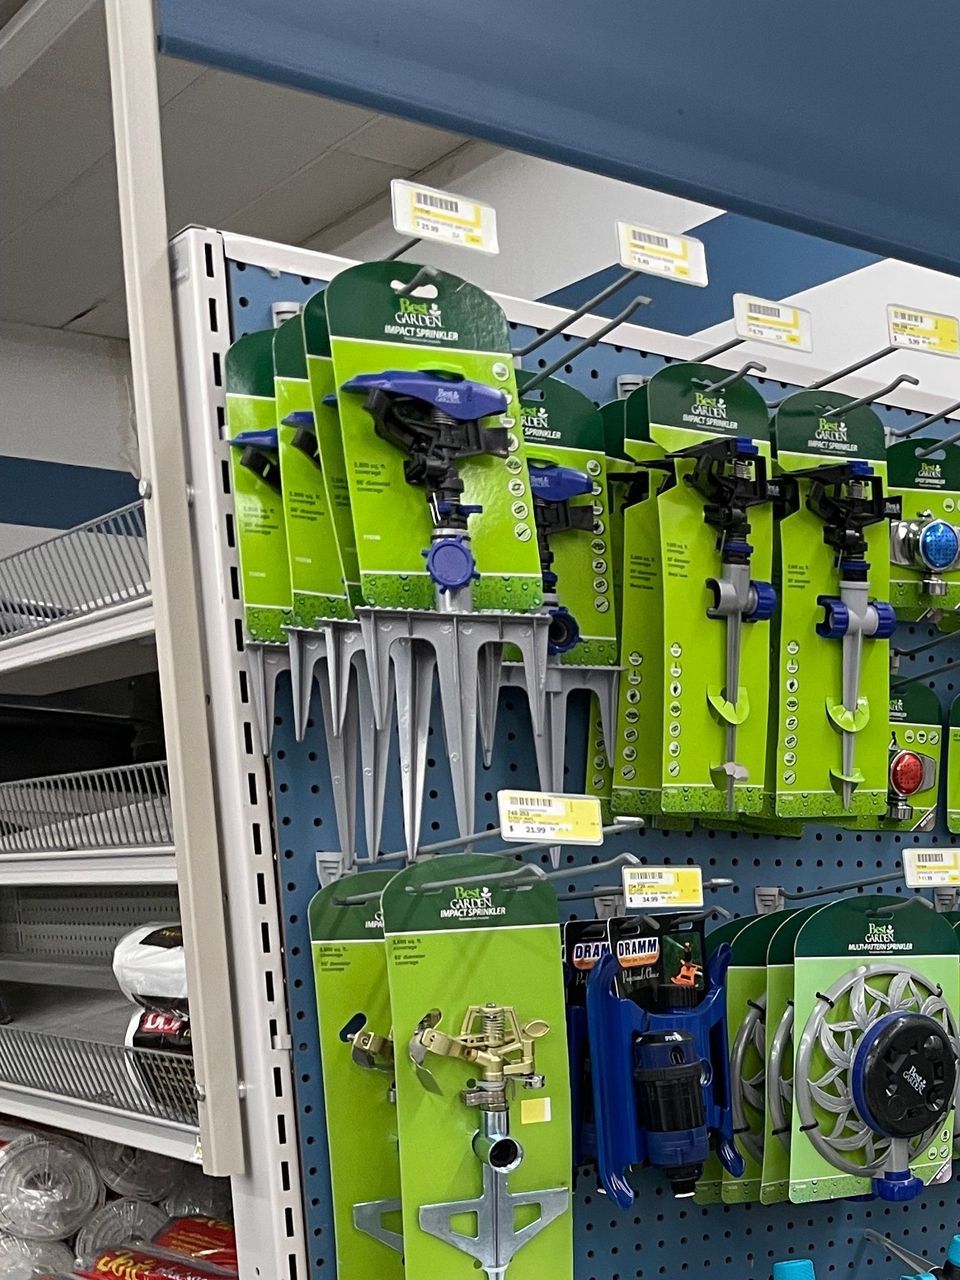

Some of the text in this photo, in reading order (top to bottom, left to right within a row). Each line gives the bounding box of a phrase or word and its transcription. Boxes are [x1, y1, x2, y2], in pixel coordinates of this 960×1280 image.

[400, 298, 428, 314] Best
[395, 312, 443, 327] GARDEN
[384, 324, 459, 341] IMPACT SPRINKLER
[695, 393, 717, 406] Best
[691, 404, 727, 418] GARDEN
[683, 414, 738, 430] IMPACT SPRINKLER
[819, 418, 839, 431] Best
[815, 429, 848, 442] GARDEN
[808, 440, 858, 451] IMPACT SPRINKLER
[526, 825, 546, 834] 21.99
[455, 886, 481, 899] Best
[450, 897, 492, 910] GARDEN
[642, 896, 659, 904] 34.99
[440, 906, 506, 918] IMPACT SPRINKLER
[869, 923, 886, 935] Best
[865, 934, 895, 943] GARDEN
[618, 938, 658, 957] DRAMM
[848, 942, 913, 951] MULTI-PATTERN SPRINKLER
